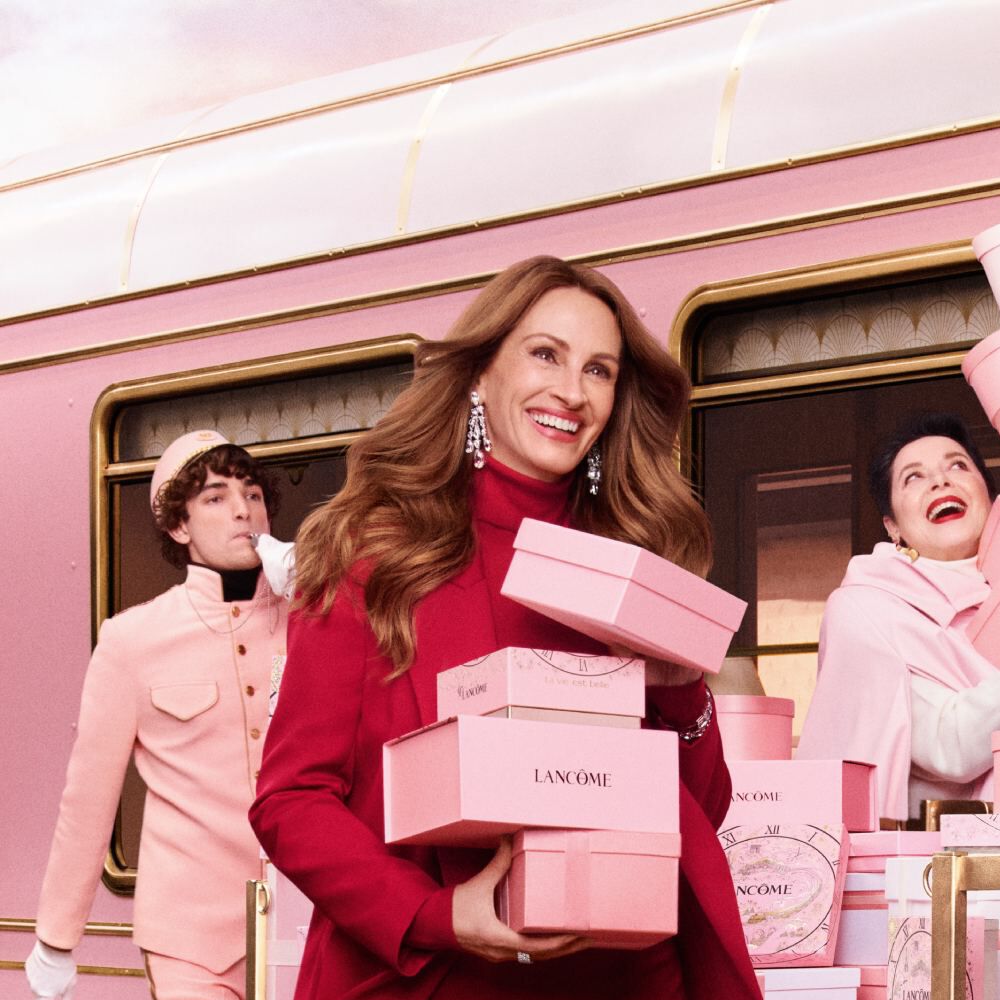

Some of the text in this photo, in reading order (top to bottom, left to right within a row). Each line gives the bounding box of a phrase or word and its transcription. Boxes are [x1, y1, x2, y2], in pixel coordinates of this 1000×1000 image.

[535, 768, 612, 787] LANCÔME
[731, 790, 783, 801] NCÔME
[736, 883, 793, 896] NCÔME
